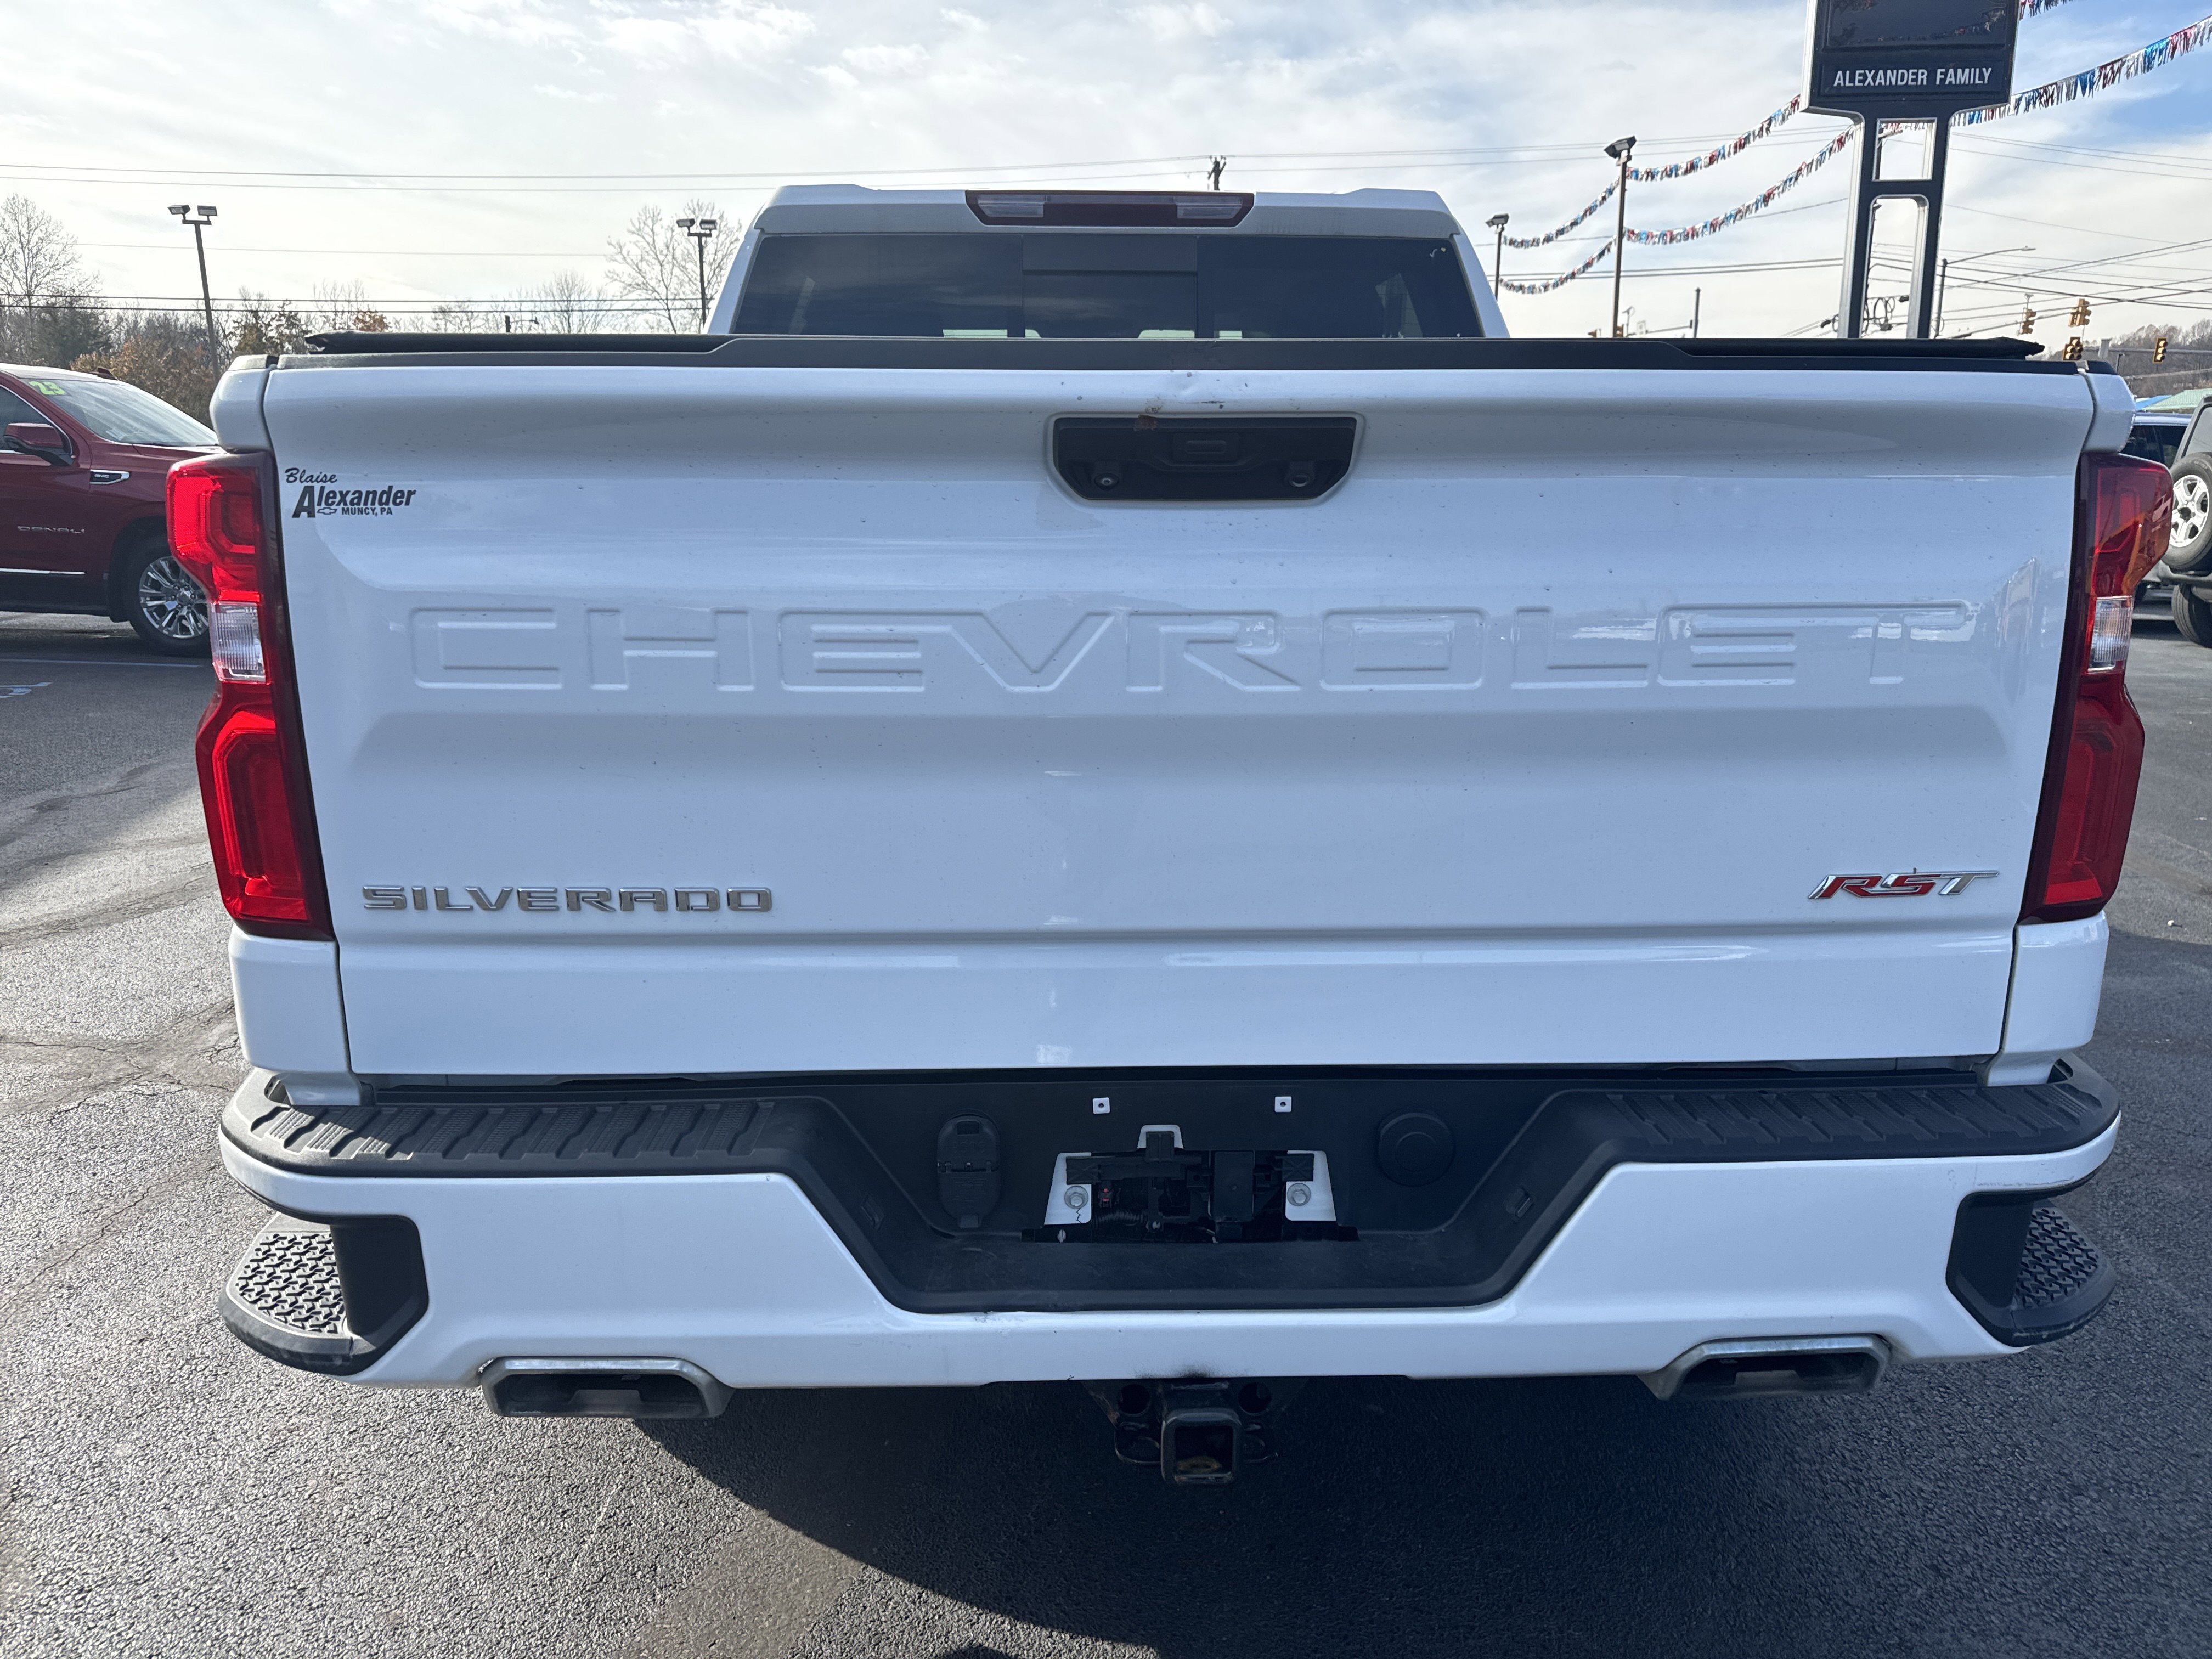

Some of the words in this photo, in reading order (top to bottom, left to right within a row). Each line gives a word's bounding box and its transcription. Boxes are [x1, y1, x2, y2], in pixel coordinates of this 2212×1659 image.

[1833, 69, 1928, 87] ALEXANDER
[1936, 67, 1992, 85] FAMILY
[28, 381, 66, 396] 23
[284, 467, 337, 483] Blaise
[291, 485, 416, 518] Alexander
[341, 507, 378, 517] MUNCY,
[380, 507, 393, 515] PA
[17, 525, 85, 534] DENALI
[410, 601, 1970, 693] CHEVROLET
[1808, 870, 2001, 900] RST
[362, 884, 772, 912] SILVERADO
